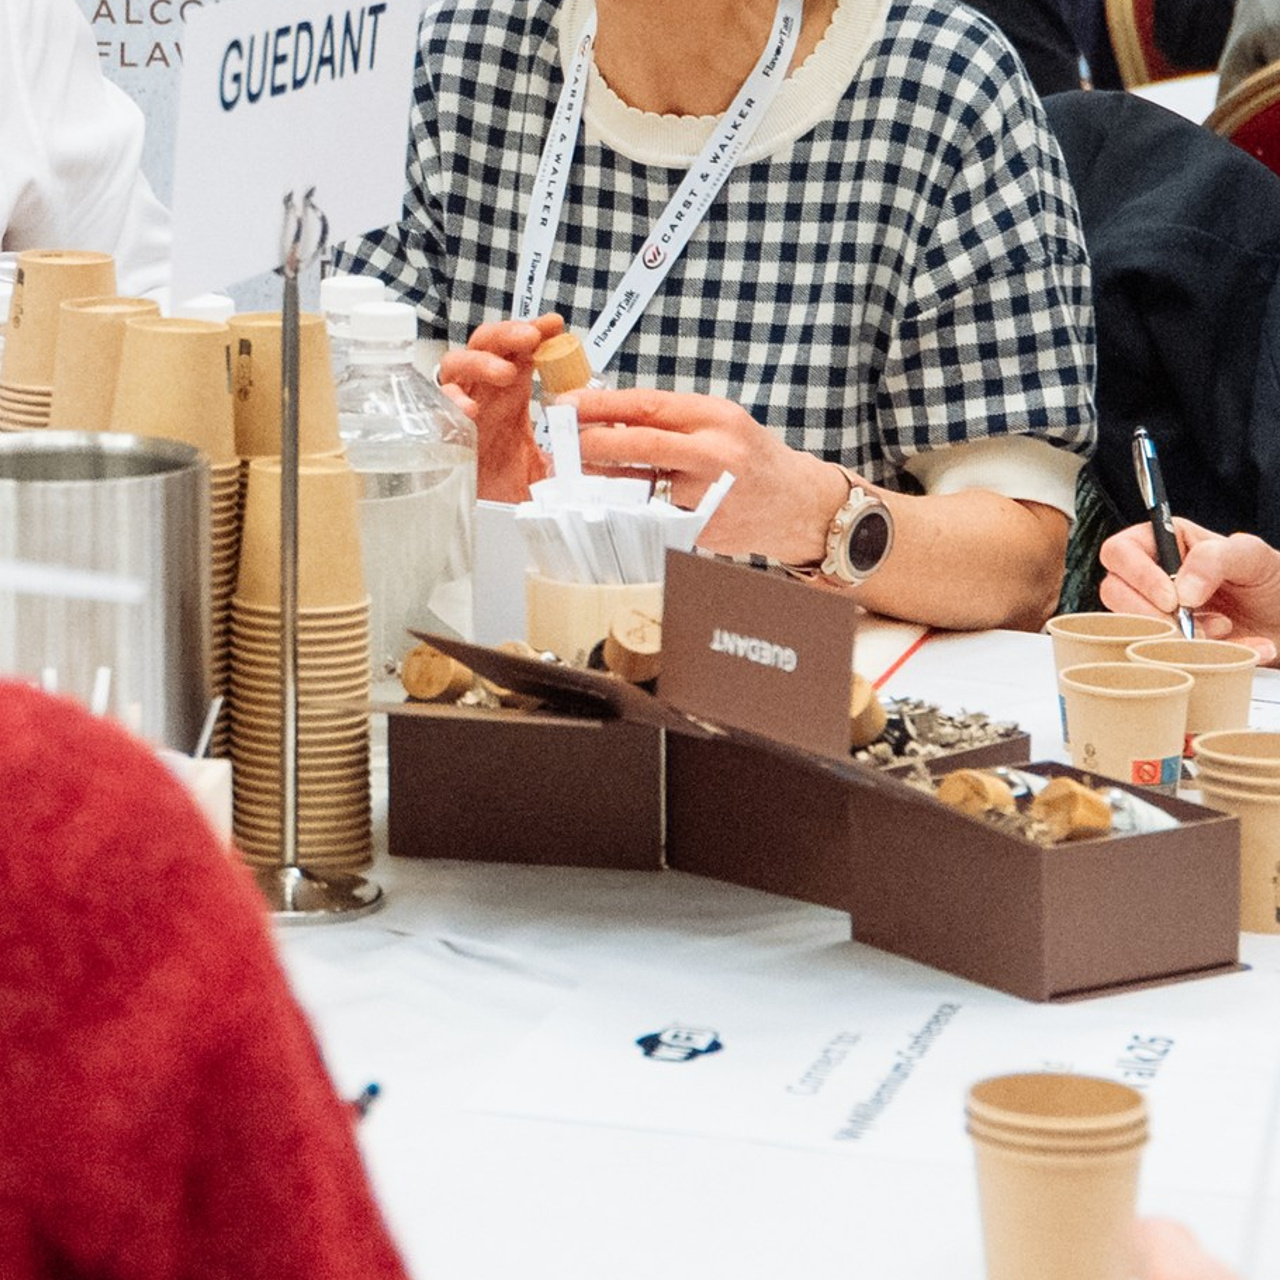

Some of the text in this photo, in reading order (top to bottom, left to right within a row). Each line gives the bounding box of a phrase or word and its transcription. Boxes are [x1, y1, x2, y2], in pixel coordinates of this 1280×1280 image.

[219, 2, 387, 112] GUEDANT
[762, 15, 790, 78] FlavourTalk
[565, 63, 583, 124] CARST
[540, 152, 563, 228] WALKER
[662, 97, 756, 244] CARST & WALKER
[522, 251, 542, 318] FlavourTalk
[593, 288, 636, 349] FlavourTalk
[709, 627, 798, 673] GUEDANT
